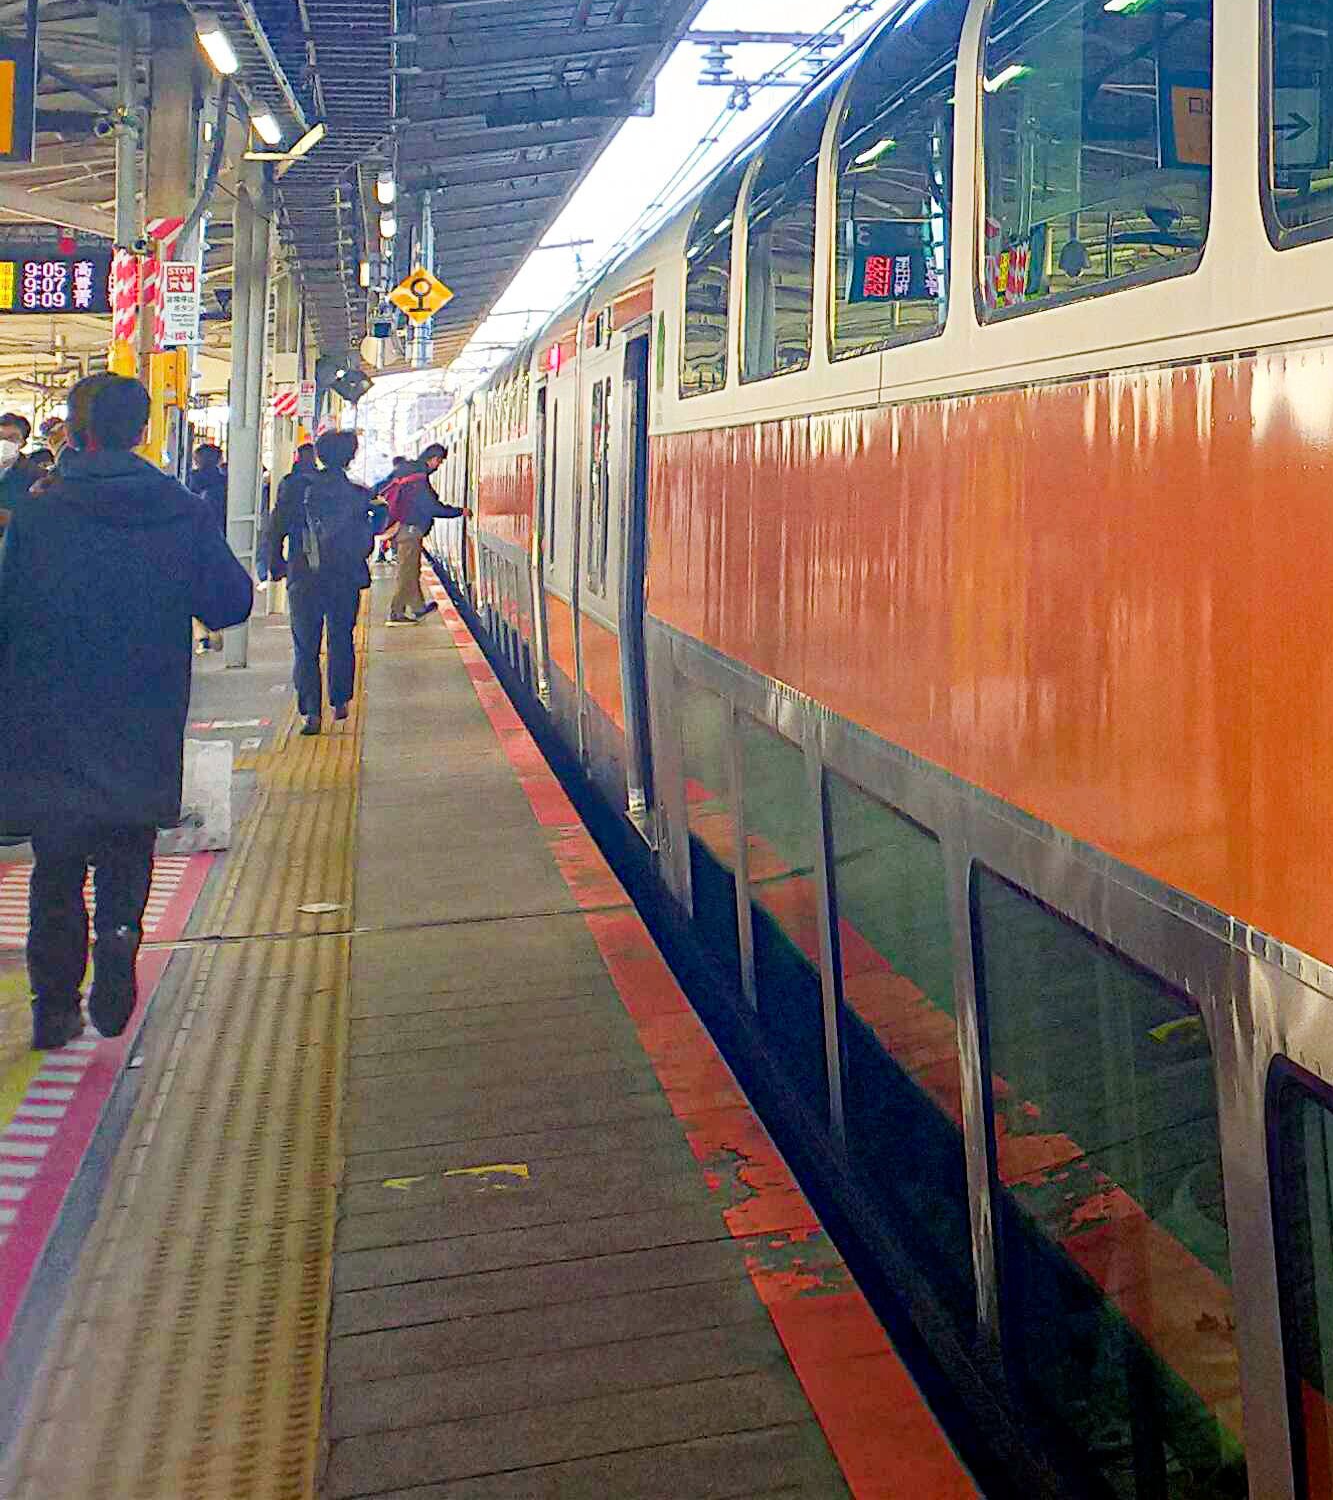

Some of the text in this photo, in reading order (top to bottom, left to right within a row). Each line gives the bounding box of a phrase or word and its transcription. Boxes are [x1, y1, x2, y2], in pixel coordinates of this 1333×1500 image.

[24, 262, 66, 278] 9:05
[167, 267, 194, 276] STOP
[23, 277, 66, 293] 9:07
[23, 292, 65, 308] 9:09
